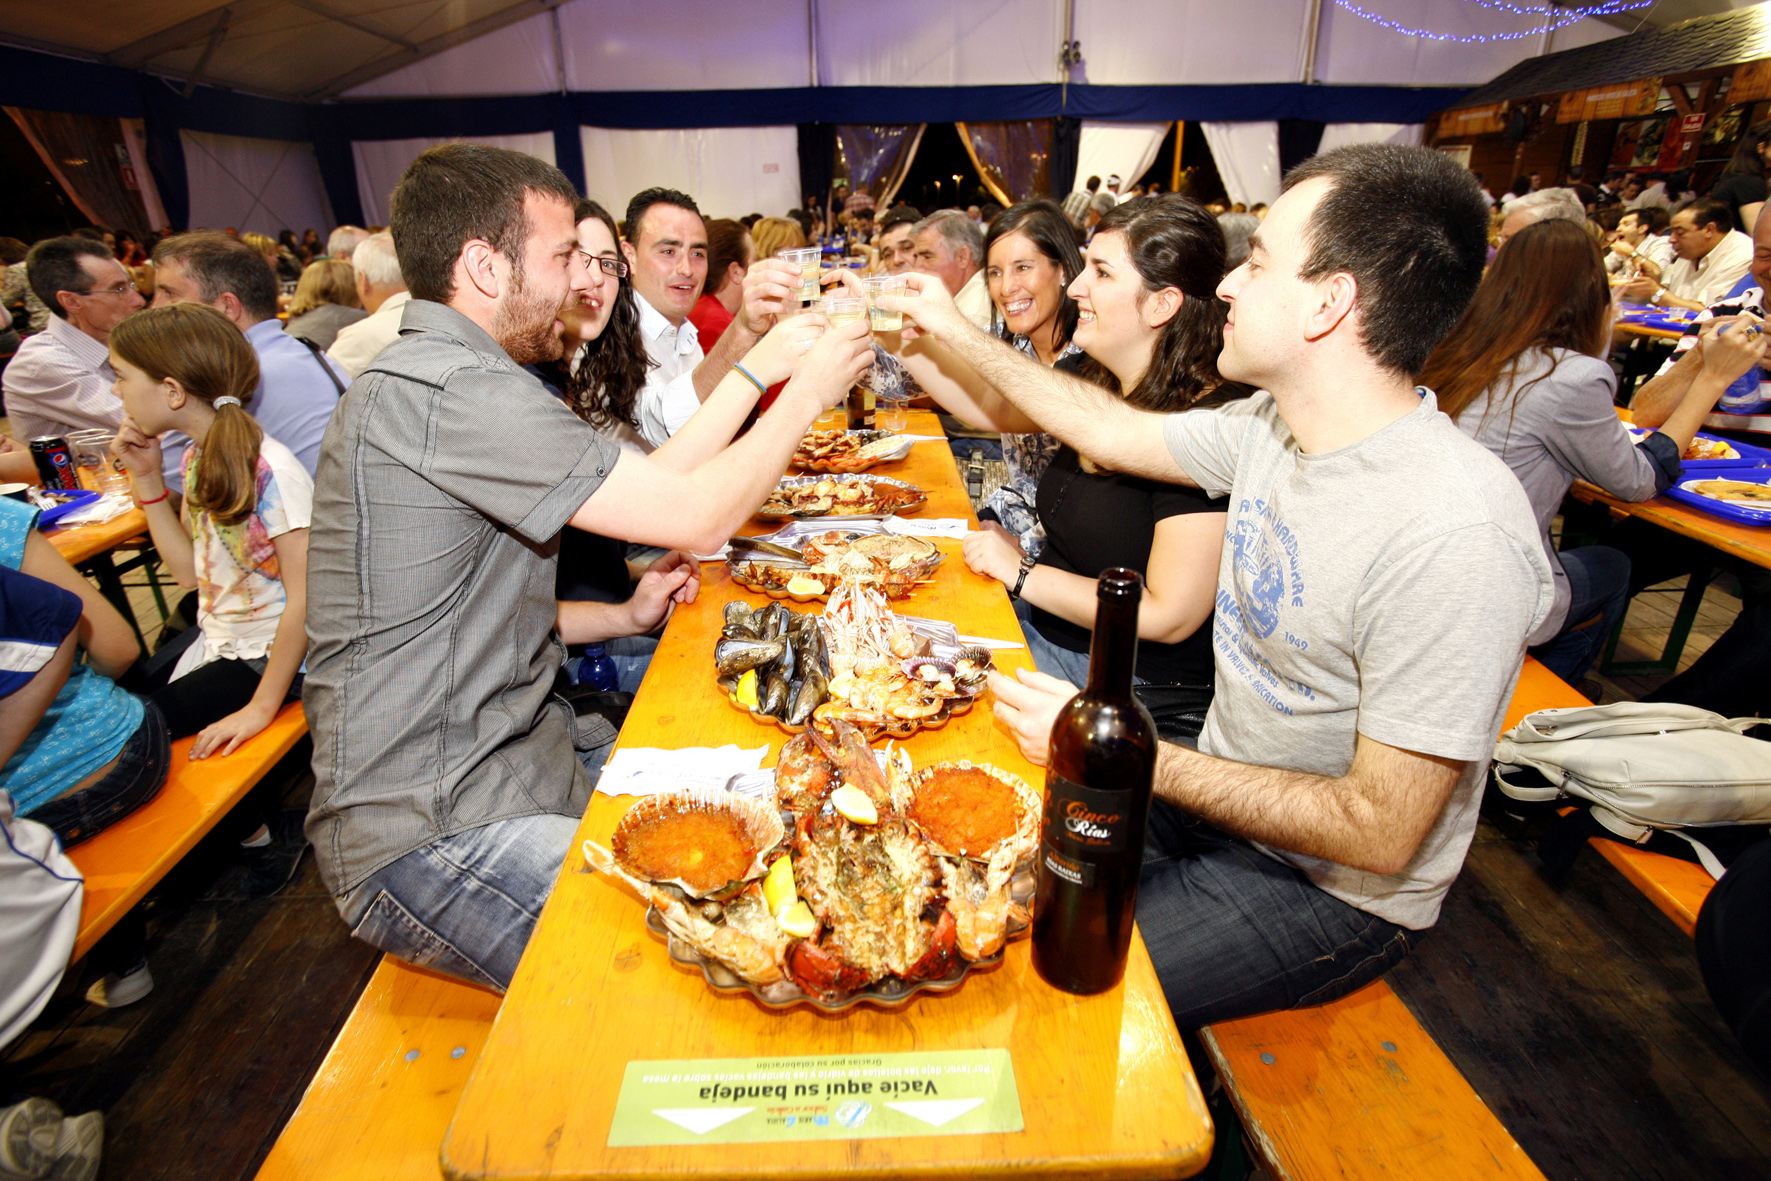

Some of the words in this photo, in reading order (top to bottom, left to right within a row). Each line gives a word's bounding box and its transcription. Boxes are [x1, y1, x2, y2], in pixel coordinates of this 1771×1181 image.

[1273, 518, 1304, 607] HARDWARE
[1231, 632, 1241, 644] &
[1284, 631, 1314, 651] 1949
[1220, 641, 1231, 653] IN
[1059, 799, 1120, 824] Cinco
[757, 1061, 814, 1070] colaboración
[831, 1058, 846, 1066] por
[848, 1058, 882, 1066] Gracias
[818, 1069, 846, 1080] vidrio
[848, 1069, 860, 1079] de
[862, 1067, 902, 1078] botellas
[904, 1067, 919, 1077] las
[943, 1065, 971, 1075] favor,
[974, 1064, 991, 1074] Por
[642, 1075, 670, 1083] mesa
[672, 1074, 681, 1084] la
[683, 1074, 711, 1083] sobre
[747, 1070, 791, 1081] bandejas
[794, 1072, 808, 1081] las
[699, 1083, 787, 1102] bandeja
[794, 1084, 819, 1096] su
[826, 1080, 873, 1101] aquí
[879, 1080, 938, 1098] Vacíe
